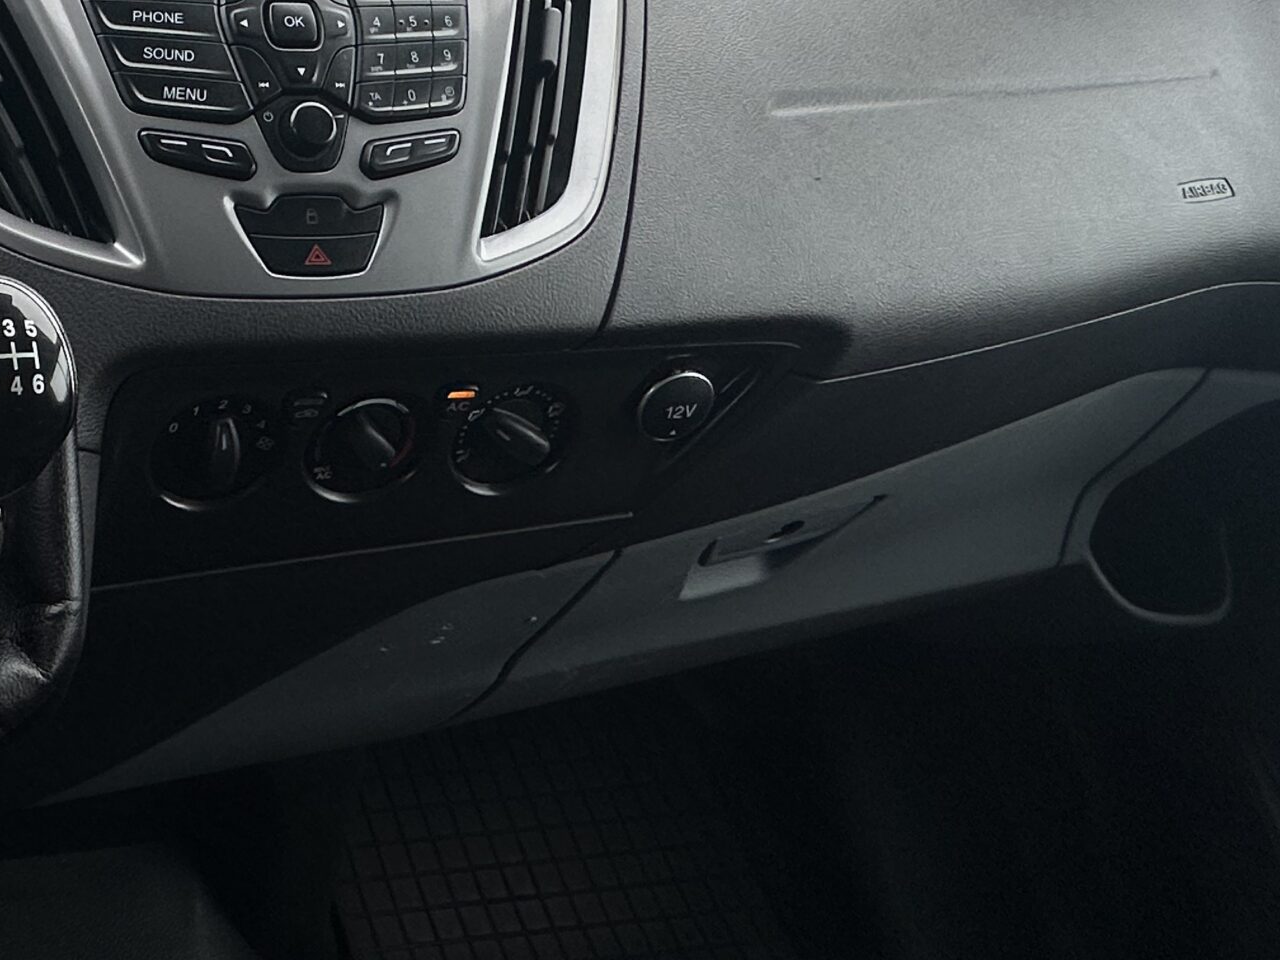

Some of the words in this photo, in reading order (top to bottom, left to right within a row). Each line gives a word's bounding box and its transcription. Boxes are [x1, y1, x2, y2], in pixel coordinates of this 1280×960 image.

[132, 10, 184, 24] PHONE
[284, 16, 305, 28] OK
[373, 17, 381, 27] 4
[408, 15, 417, 27] 5
[143, 47, 195, 62] SOUND
[377, 53, 384, 65] 7
[410, 51, 419, 63] 8
[443, 49, 451, 61] 9
[163, 86, 207, 101] MENU
[2, 319, 16, 337] 3
[24, 319, 37, 338] 5
[10, 376, 23, 396] 4
[32, 374, 45, 394] 6
[665, 403, 697, 420] 12V
